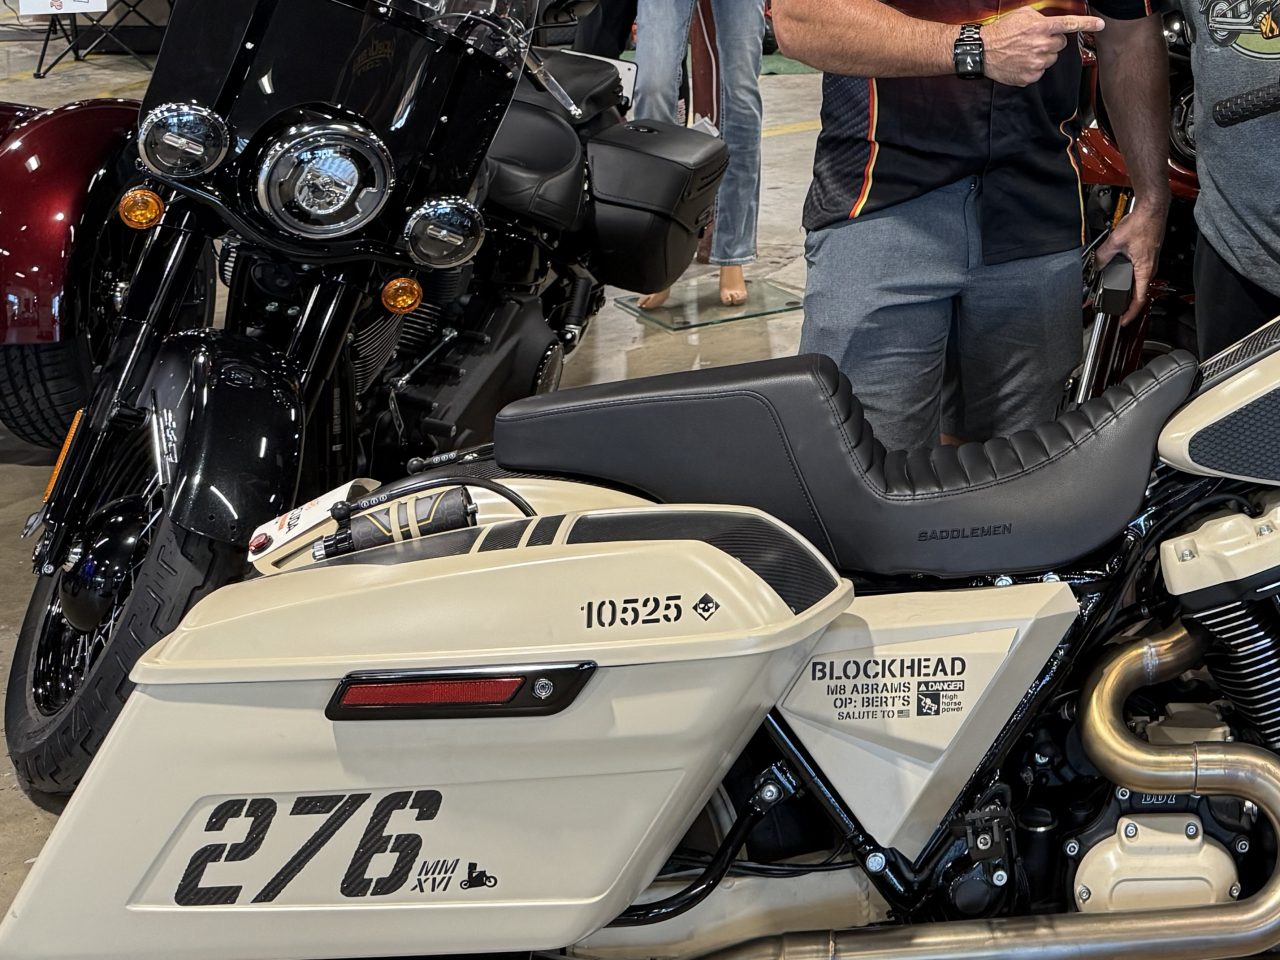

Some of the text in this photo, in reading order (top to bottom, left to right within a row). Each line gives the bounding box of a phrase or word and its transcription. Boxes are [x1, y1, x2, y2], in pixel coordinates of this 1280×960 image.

[918, 523, 1012, 542] SADDLEMEN
[580, 595, 683, 628] 10525
[811, 657, 966, 681] BLOCKHEAD
[826, 681, 911, 696] M8 ABRAMS
[928, 681, 964, 691] DANGER
[833, 695, 911, 709] OP: BERT'S
[941, 706, 963, 714] power
[837, 709, 895, 721] SALUTE TO
[175, 790, 442, 907] 276
[418, 858, 459, 876] MM
[410, 876, 454, 893] XVI
